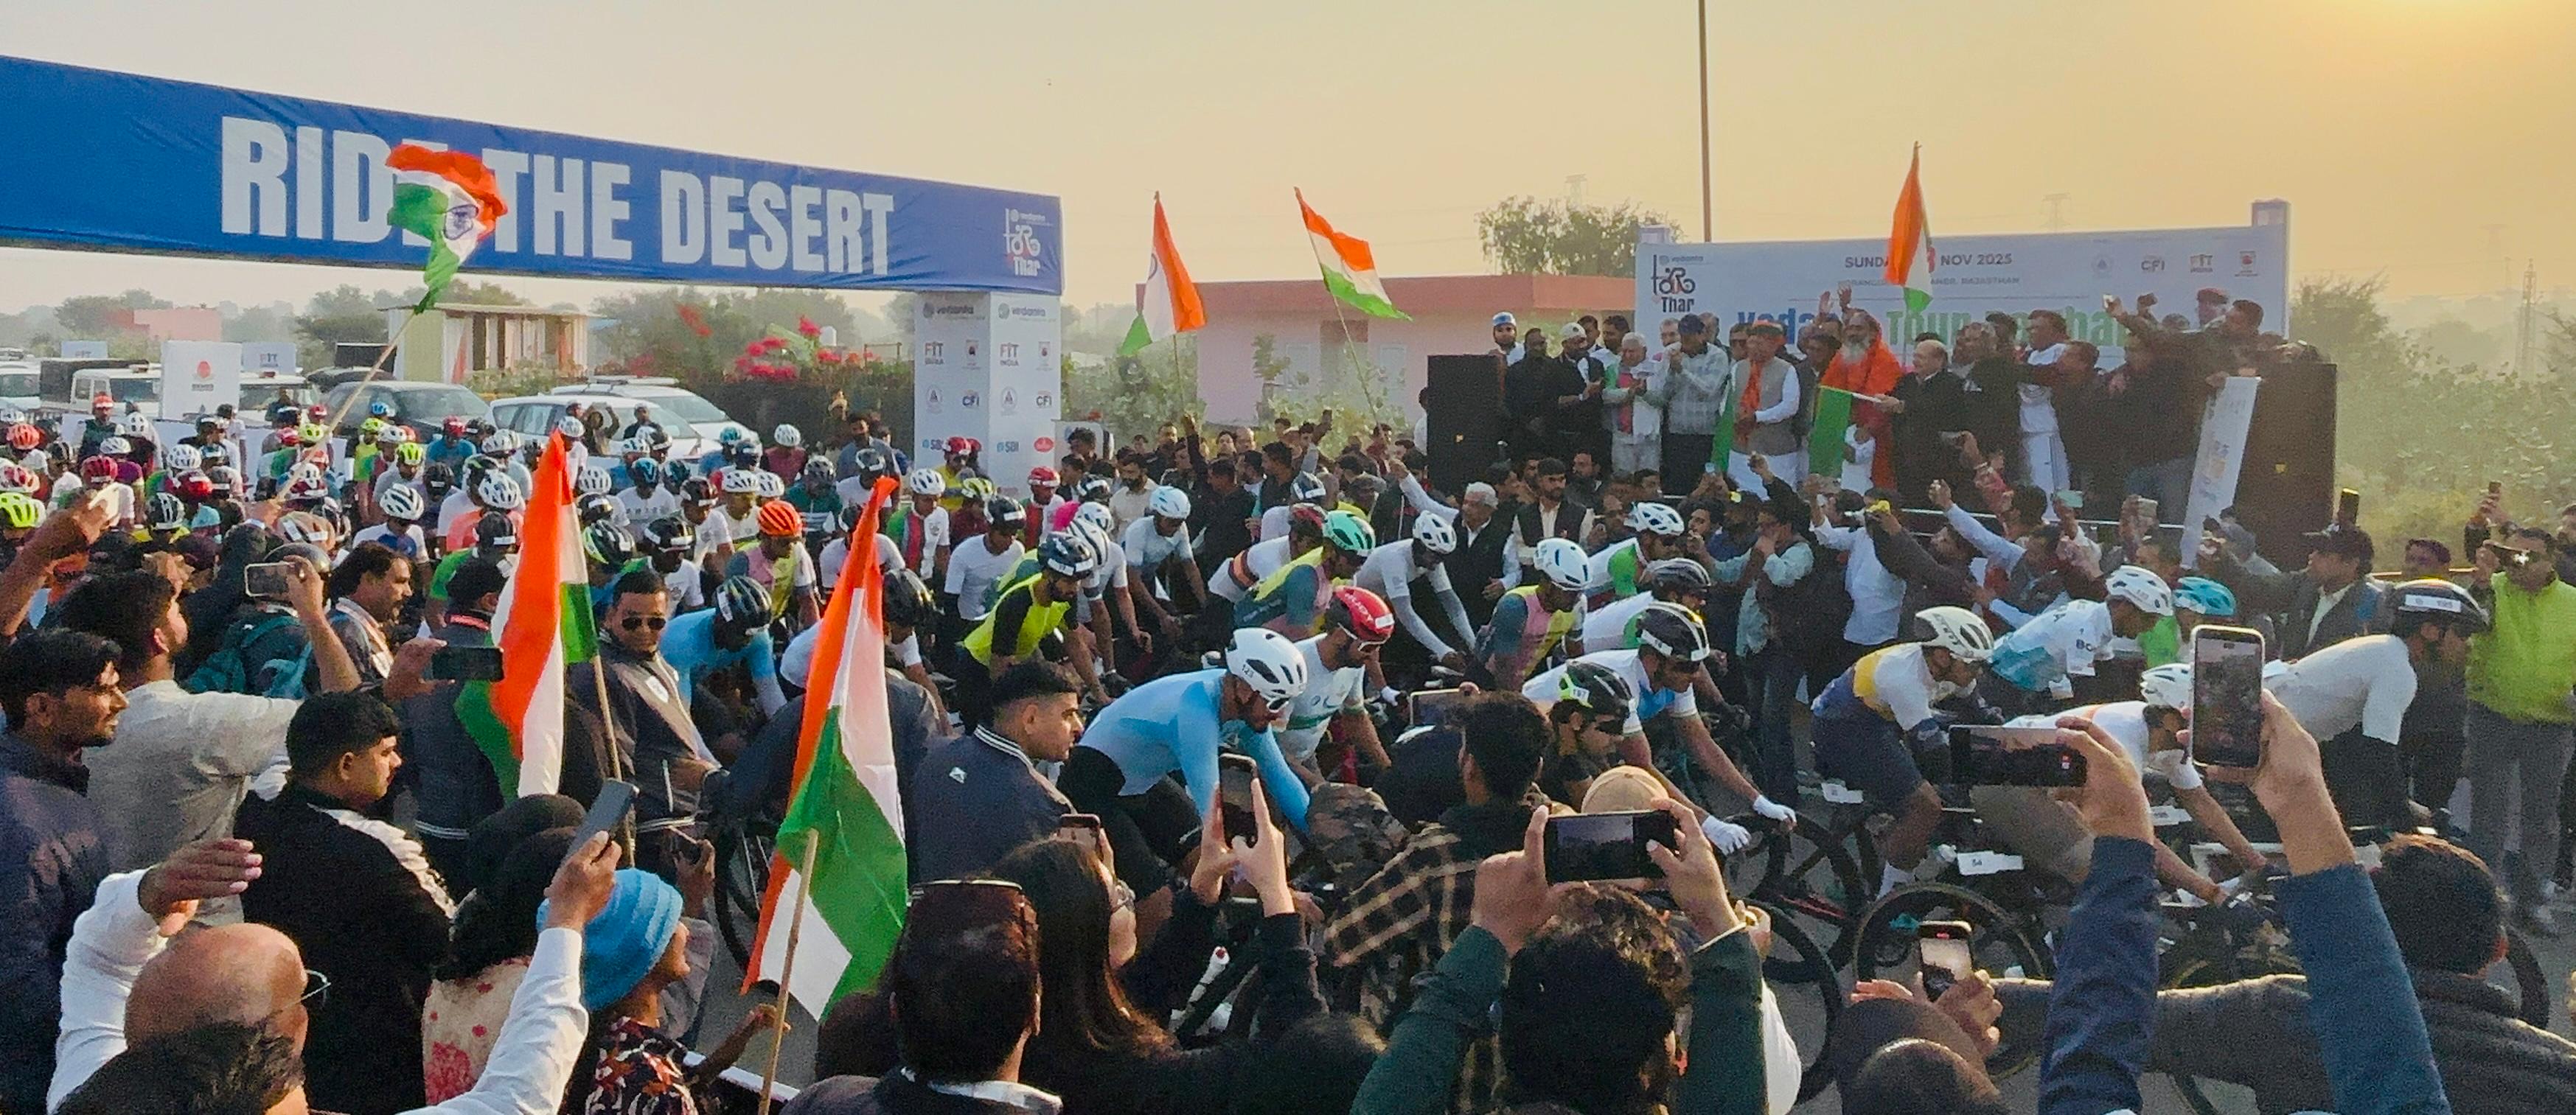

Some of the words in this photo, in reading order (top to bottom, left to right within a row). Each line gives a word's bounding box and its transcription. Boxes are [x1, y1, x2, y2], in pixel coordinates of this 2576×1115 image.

[481, 148, 633, 261] THE
[660, 169, 894, 276] DESERT
[1014, 256, 1041, 276] Thar
[1845, 256, 1889, 268] SUND
[1940, 254, 1972, 266] NOV
[1977, 253, 2013, 265] 2025
[2140, 259, 2165, 272] CFI
[1661, 296, 1695, 313] Thar
[924, 341, 944, 356] FIT
[1000, 342, 1020, 357] FIT
[962, 395, 980, 407] CFI
[1036, 395, 1053, 406] CFI
[1004, 441, 1020, 453] SBI
